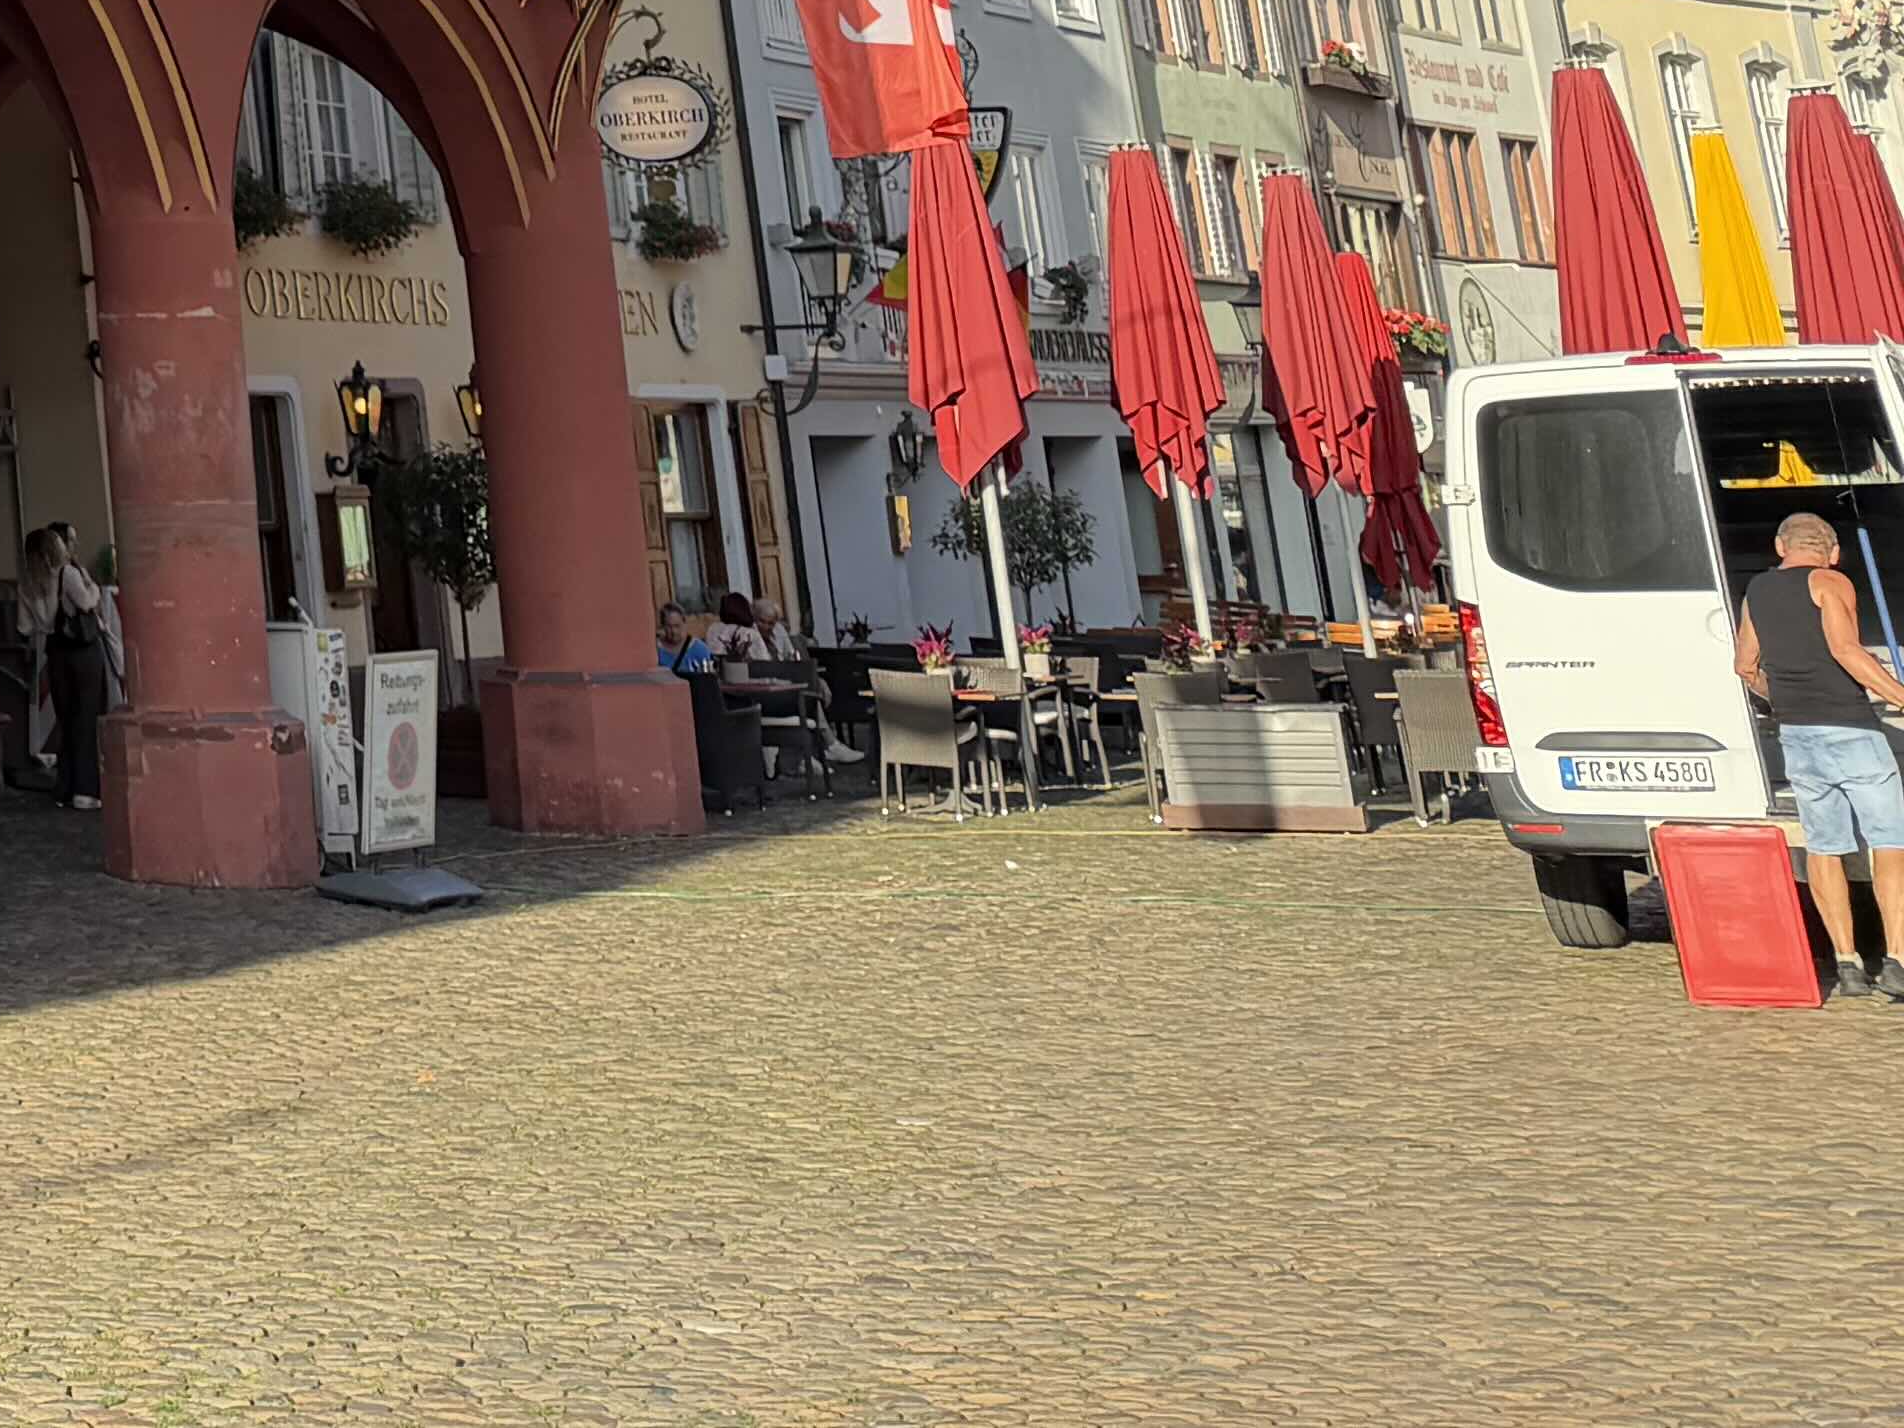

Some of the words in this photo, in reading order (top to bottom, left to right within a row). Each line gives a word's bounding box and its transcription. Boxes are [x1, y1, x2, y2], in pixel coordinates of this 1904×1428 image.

[632, 93, 669, 105] HOTEL
[600, 107, 704, 128] OBERKIRCH
[620, 129, 688, 142] RESTAURANT
[244, 265, 449, 327] OBERKIRCHS
[1575, 761, 1604, 783] FR
[1620, 761, 1648, 783] KS
[1654, 761, 1709, 783] 4580
